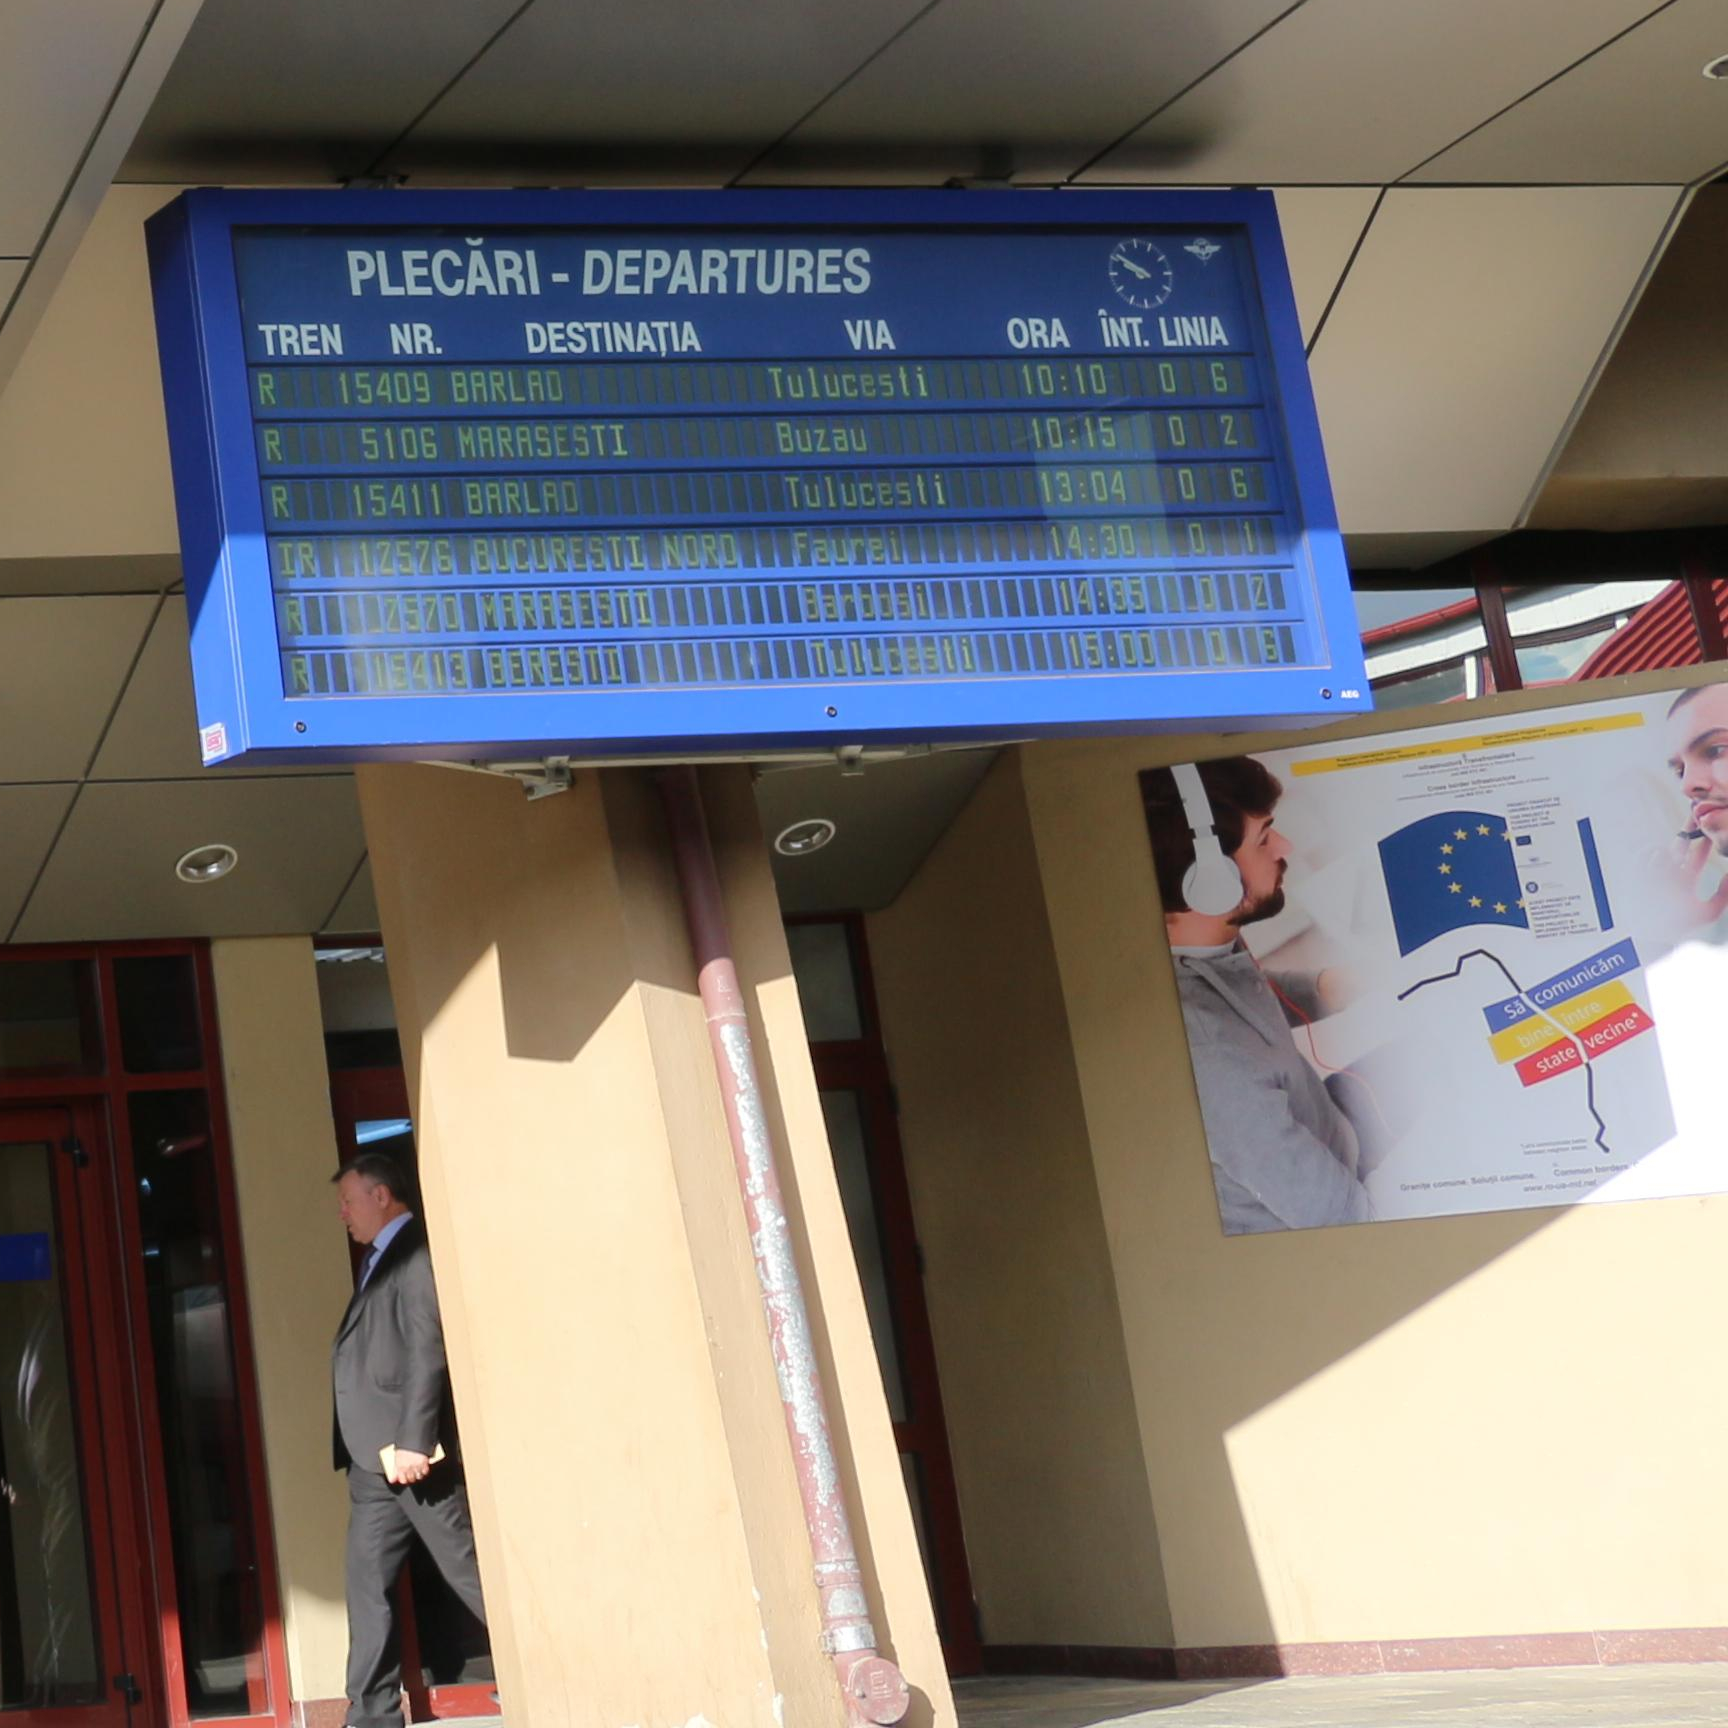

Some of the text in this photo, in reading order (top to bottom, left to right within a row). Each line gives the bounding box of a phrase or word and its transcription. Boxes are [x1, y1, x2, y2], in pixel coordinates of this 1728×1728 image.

[347, 237, 540, 297] PLECĂRI
[582, 248, 871, 295] DEPARTURES
[258, 309, 1229, 357] TREN NR. DESTINAȚIA VIA ORA ÎNT. LINIA
[258, 373, 276, 405] R
[339, 372, 431, 404] 15409
[768, 366, 928, 398] Tulucesti
[1023, 364, 1107, 395] 10:10
[1159, 363, 1176, 393] 0
[1211, 362, 1228, 393] 6
[264, 415, 1238, 461] R 5106 MARASESTI Buzau 10:15 0 2
[271, 485, 289, 518] R
[353, 483, 440, 517] 15411
[785, 474, 946, 508] Tulucesti
[1040, 470, 1126, 503] 13:04
[1179, 468, 1196, 500] 0
[1231, 468, 1248, 498] 6
[277, 541, 316, 577] IR
[359, 539, 453, 576] 12576
[473, 536, 644, 572] BUCURESTI
[794, 530, 900, 564] Faurei
[1049, 524, 1136, 558] 14:30
[1188, 523, 1206, 555] 0
[1243, 521, 1254, 554] 1
[286, 598, 303, 634] R
[483, 591, 652, 628] MARASESTI
[1059, 578, 1145, 612] 14:35
[1252, 576, 1268, 609] 2
[292, 656, 309, 690] R
[490, 648, 621, 684] BERESTI
[1263, 630, 1278, 661] 6
[1340, 689, 1360, 699] AEG
[1503, 952, 1625, 1019] Să comunicăm
[1516, 1023, 1555, 1048] bine
[1536, 1045, 1577, 1073] state
